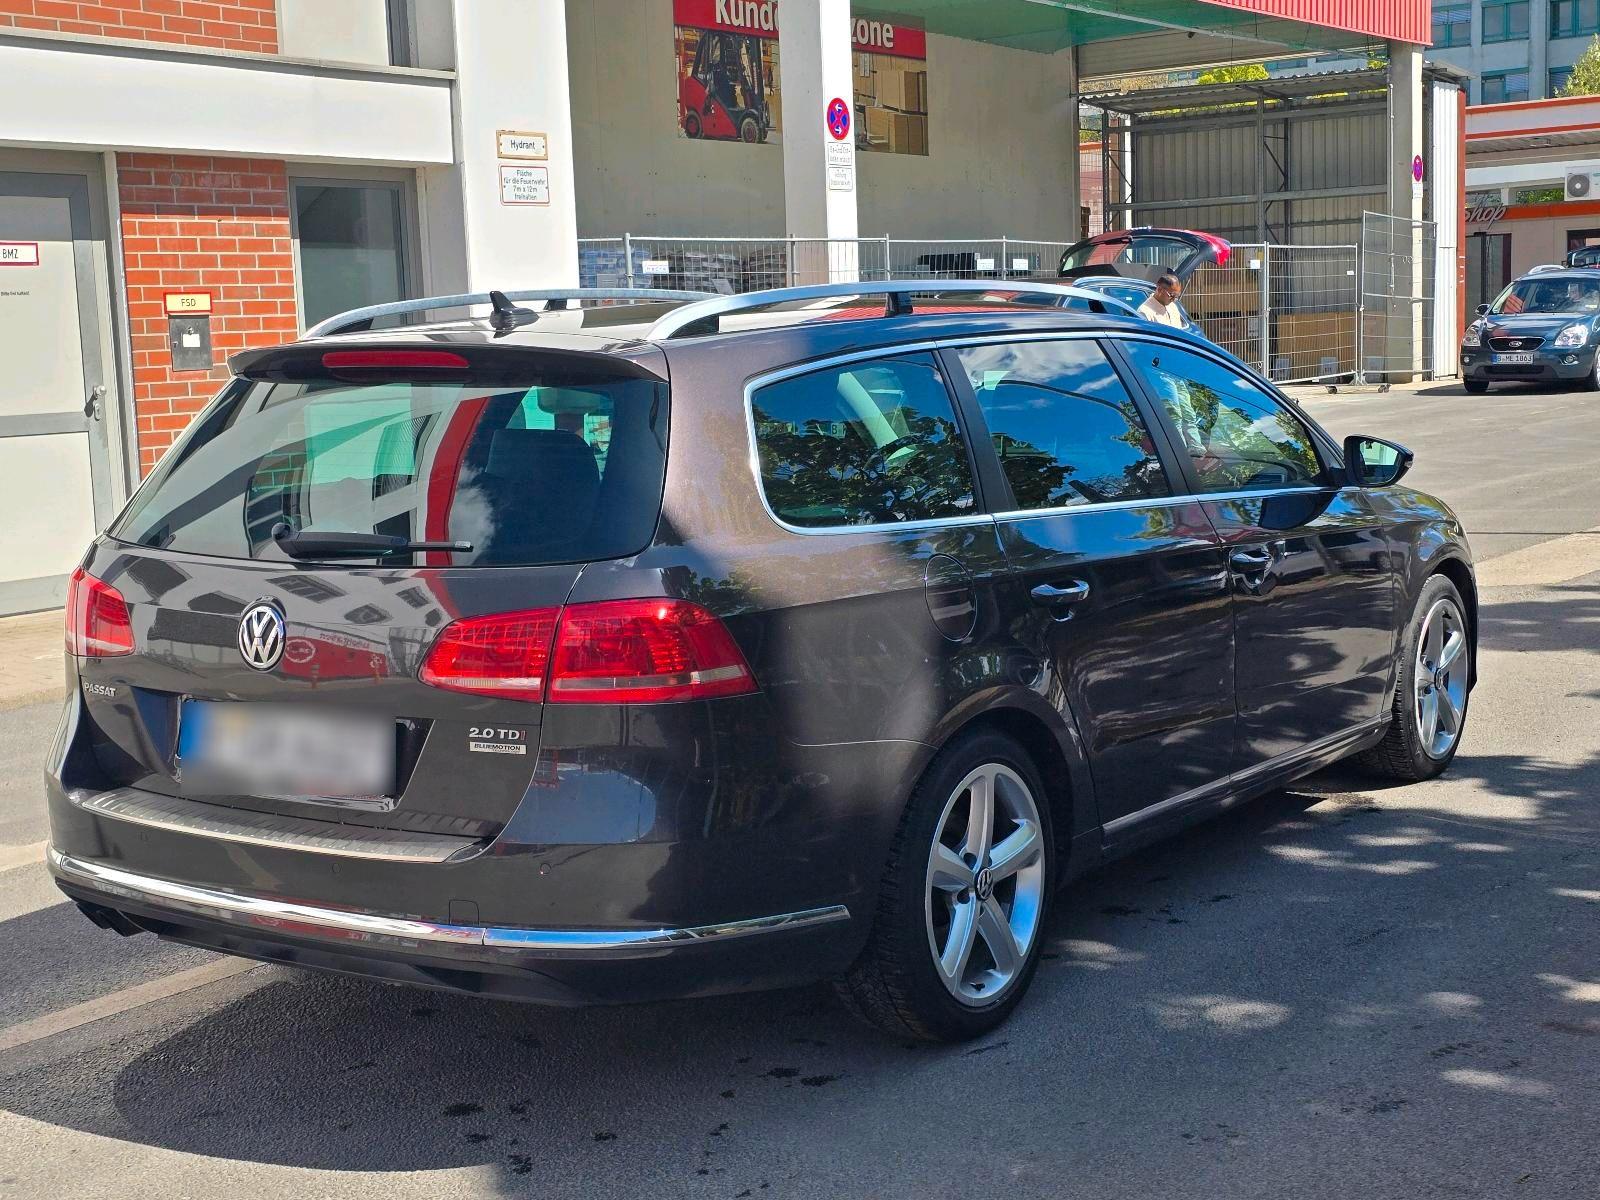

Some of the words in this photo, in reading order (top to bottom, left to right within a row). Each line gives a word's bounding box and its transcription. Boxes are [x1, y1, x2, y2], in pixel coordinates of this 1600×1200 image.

[715, 0, 779, 31] Kund
[510, 139, 536, 151] Hydrant
[2, 248, 19, 259] BMZ
[180, 298, 197, 307] FSD
[83, 682, 117, 697] PASSAT
[469, 727, 495, 739] 2.0
[497, 728, 527, 741] TDI
[474, 743, 521, 751] BLUEMOTION
